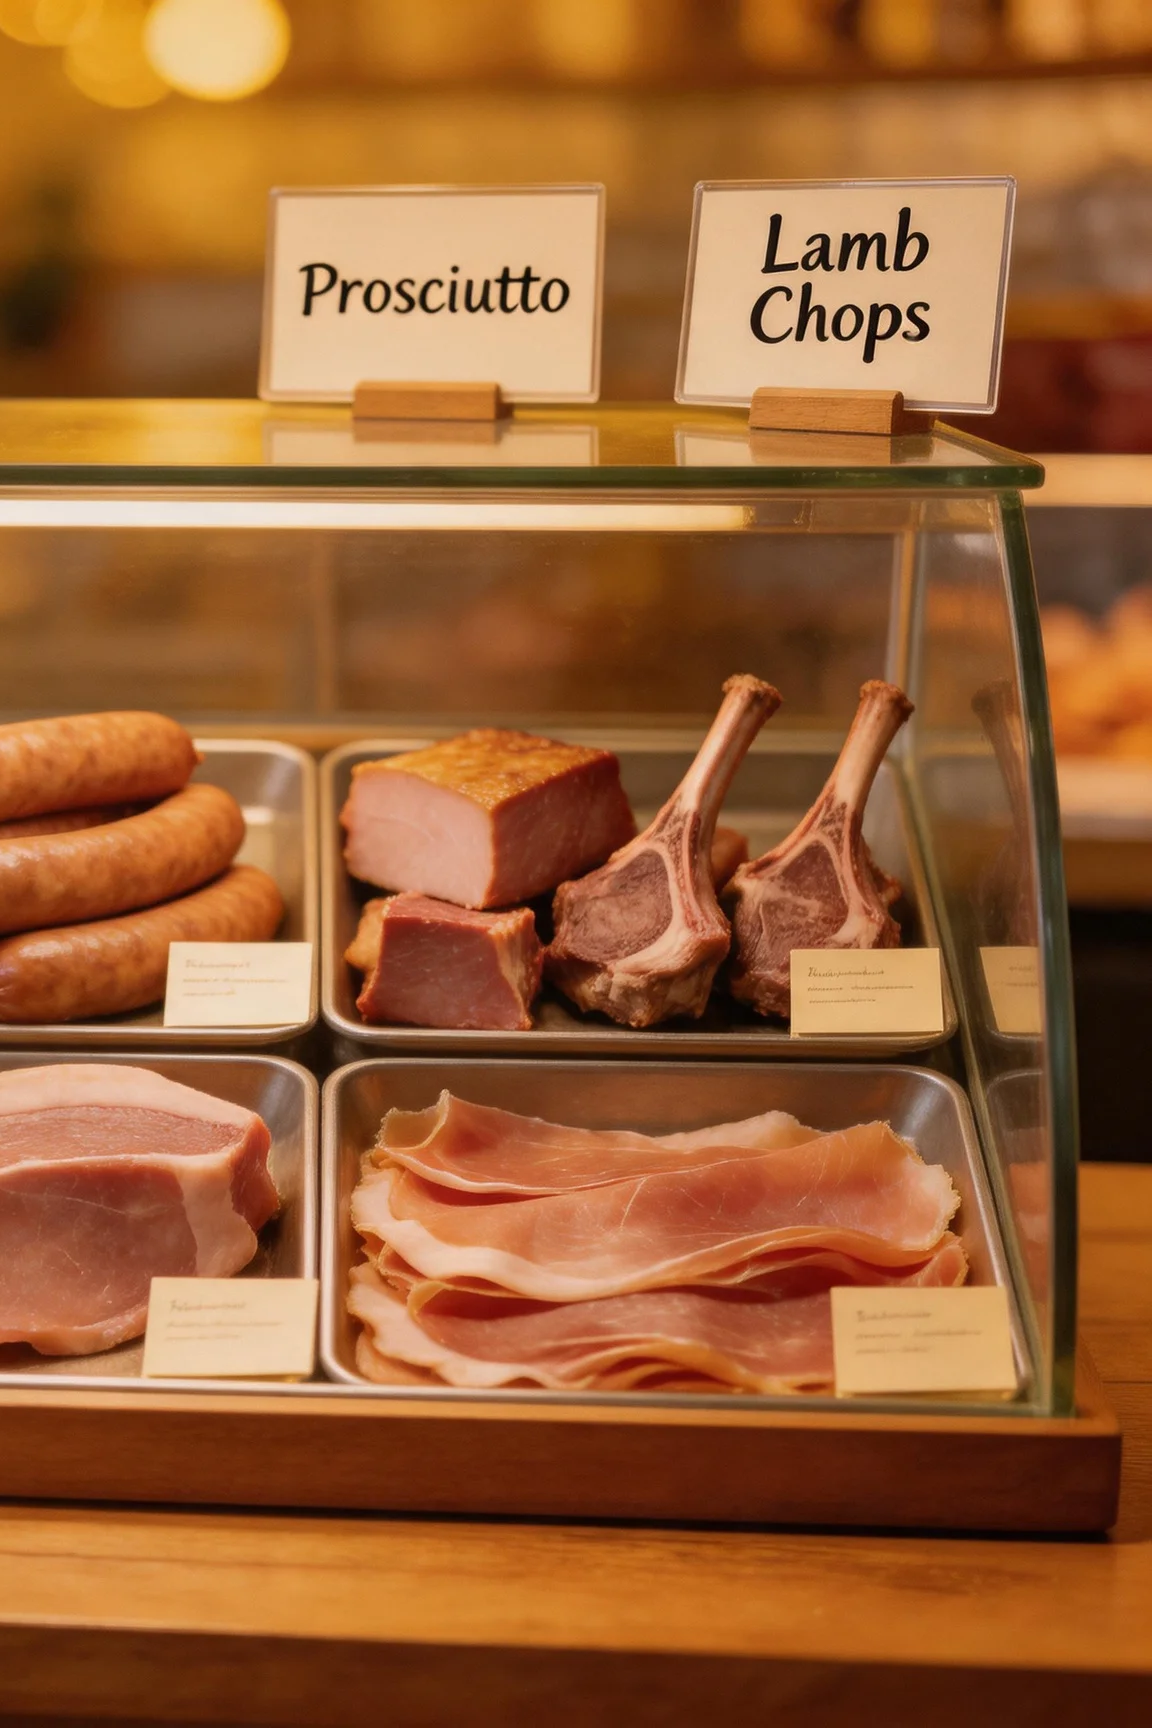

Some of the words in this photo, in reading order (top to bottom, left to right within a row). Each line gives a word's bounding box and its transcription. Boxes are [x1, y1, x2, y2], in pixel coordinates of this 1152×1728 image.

[760, 206, 930, 274] Lamb
[298, 262, 571, 318] Prosciutto
[749, 281, 931, 365] Chops
